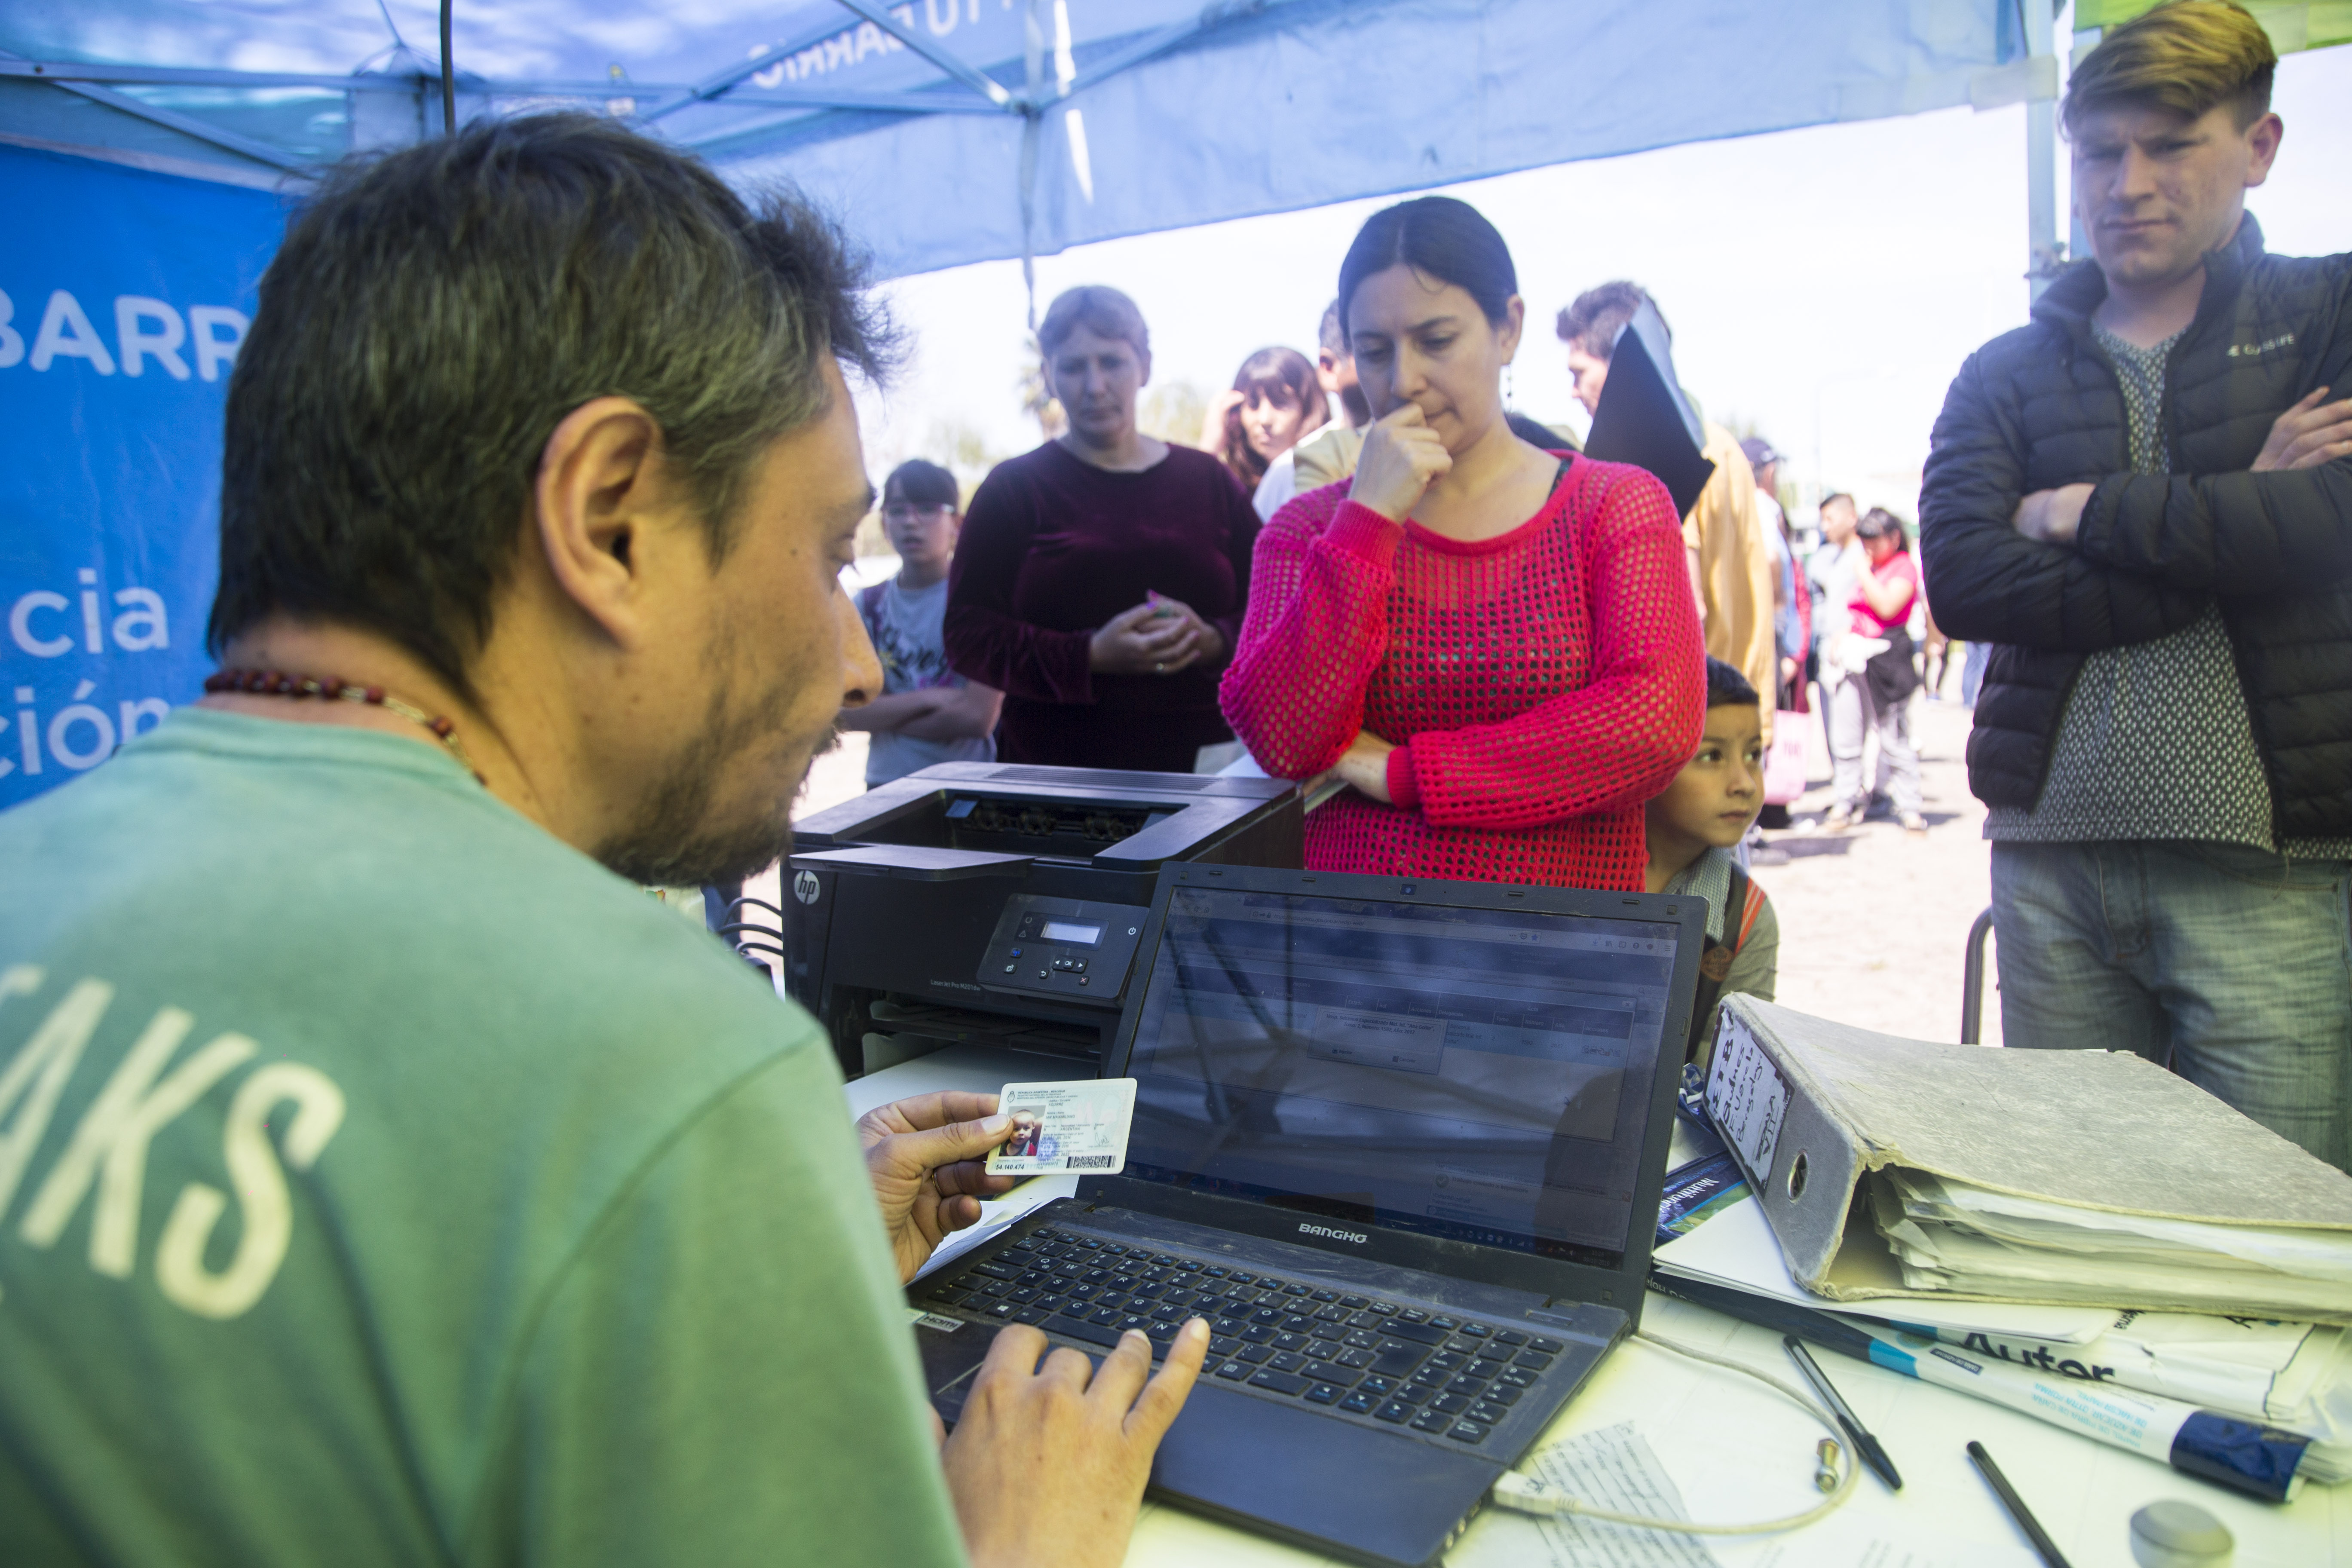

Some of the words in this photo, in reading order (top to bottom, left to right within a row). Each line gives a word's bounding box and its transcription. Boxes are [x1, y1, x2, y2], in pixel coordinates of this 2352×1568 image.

[798, 870, 816, 904] hp
[931, 979, 950, 987] LaserJet
[0, 964, 345, 1321] AKS
